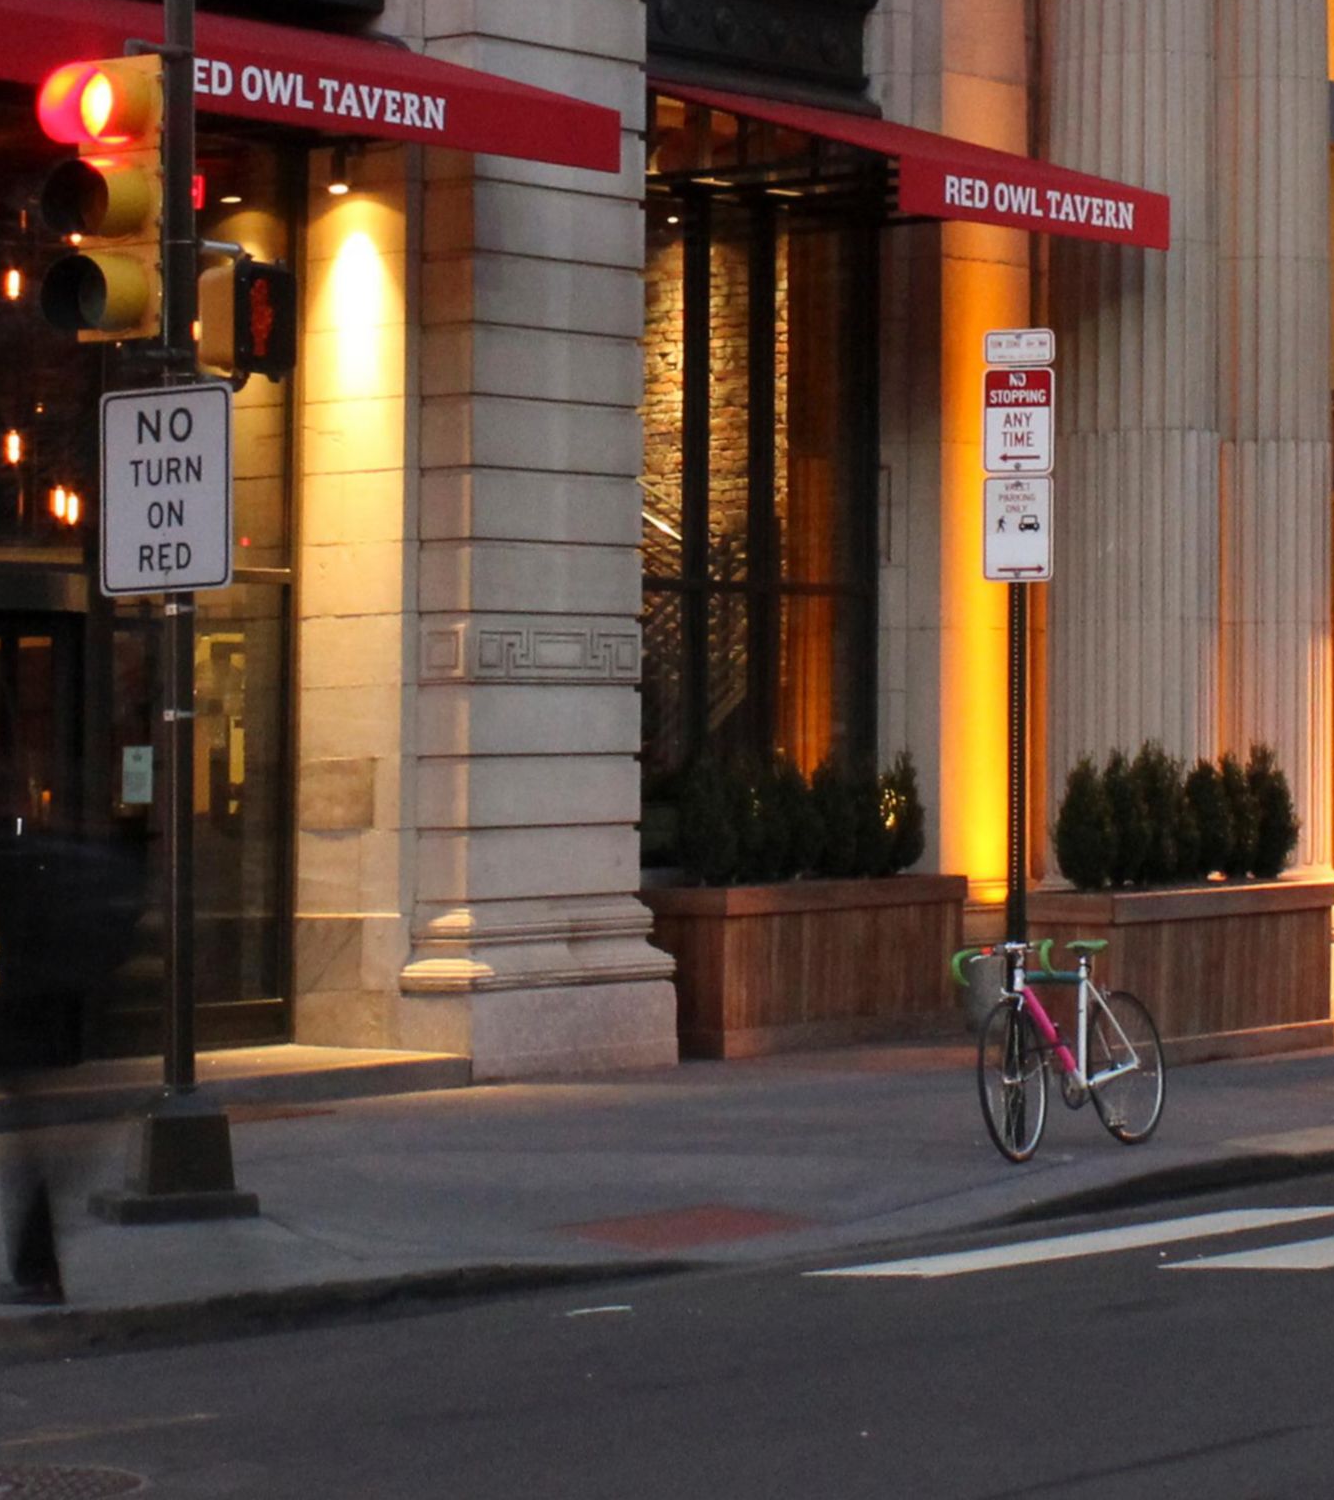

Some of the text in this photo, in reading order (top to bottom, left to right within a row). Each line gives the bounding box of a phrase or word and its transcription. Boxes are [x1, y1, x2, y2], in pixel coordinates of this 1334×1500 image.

[192, 57, 447, 131] ED OWL TAVERN
[945, 174, 1135, 231] RED OWL TAVERN
[1009, 372, 1027, 387] NO
[989, 389, 1047, 404] STOPPING
[136, 407, 193, 444] NO
[1003, 412, 1033, 428] ANY
[1001, 431, 1034, 448] TIME
[129, 455, 202, 487] TURN
[147, 499, 185, 529] ON
[138, 542, 192, 572] RED
